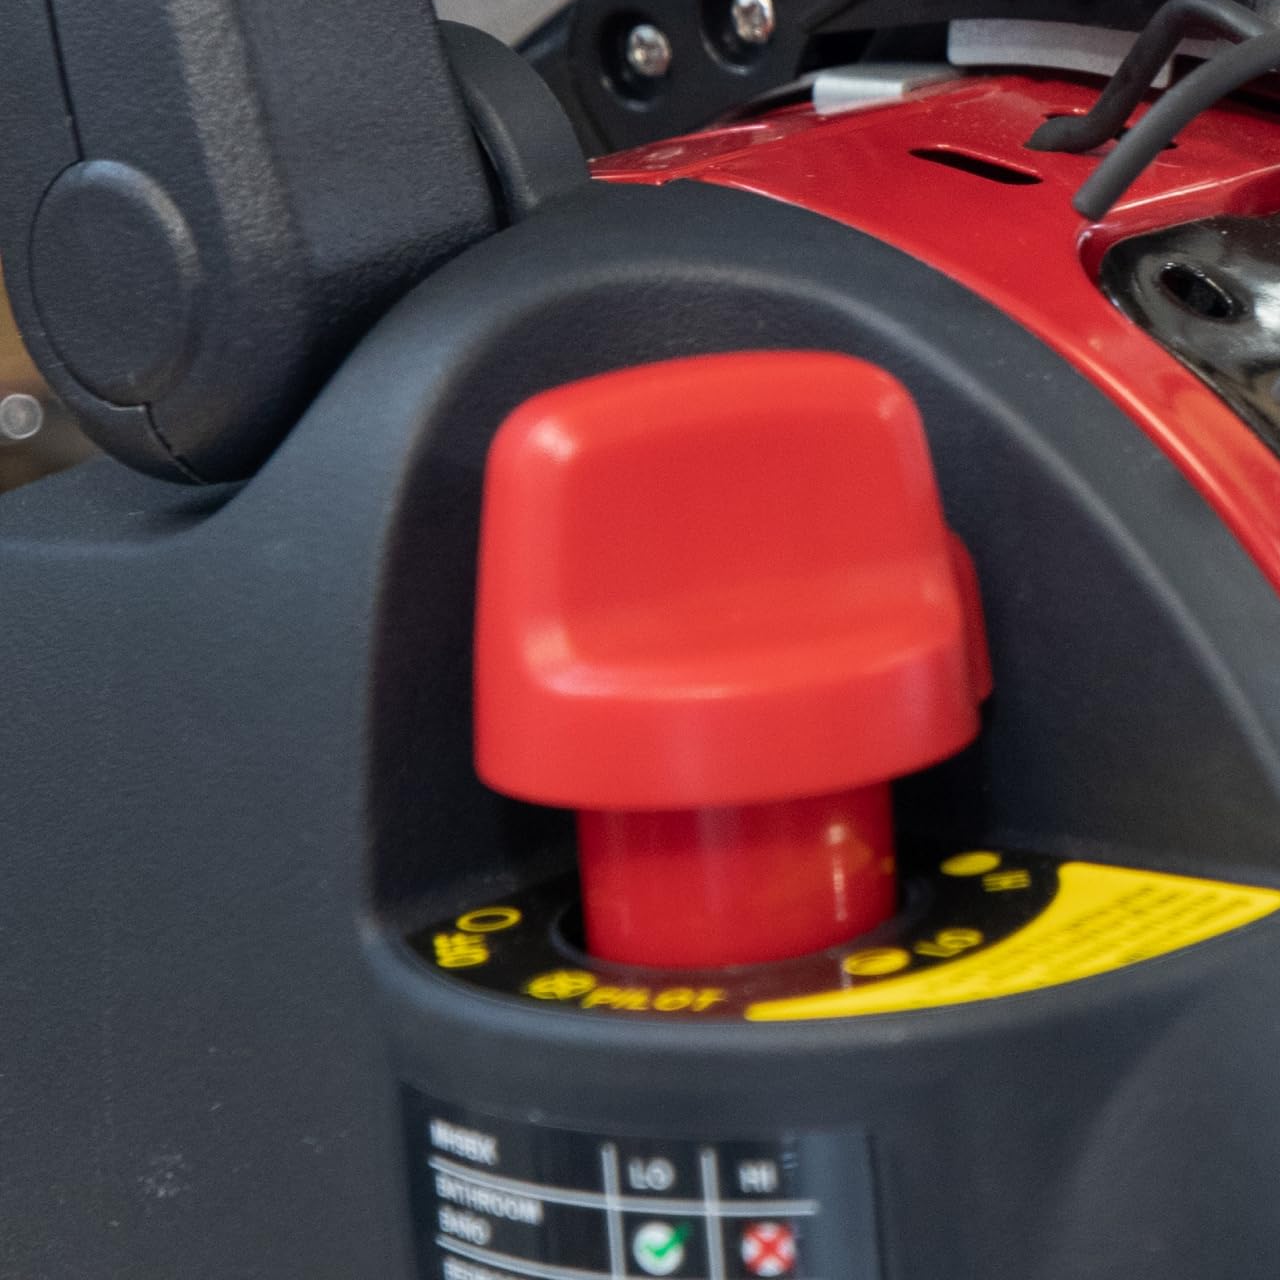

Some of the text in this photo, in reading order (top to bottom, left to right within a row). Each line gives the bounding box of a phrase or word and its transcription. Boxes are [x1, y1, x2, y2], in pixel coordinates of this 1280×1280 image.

[582, 985, 727, 1012] PILOT
[628, 1157, 778, 1193] LO HI
[435, 1172, 545, 1226] BATHROOM
